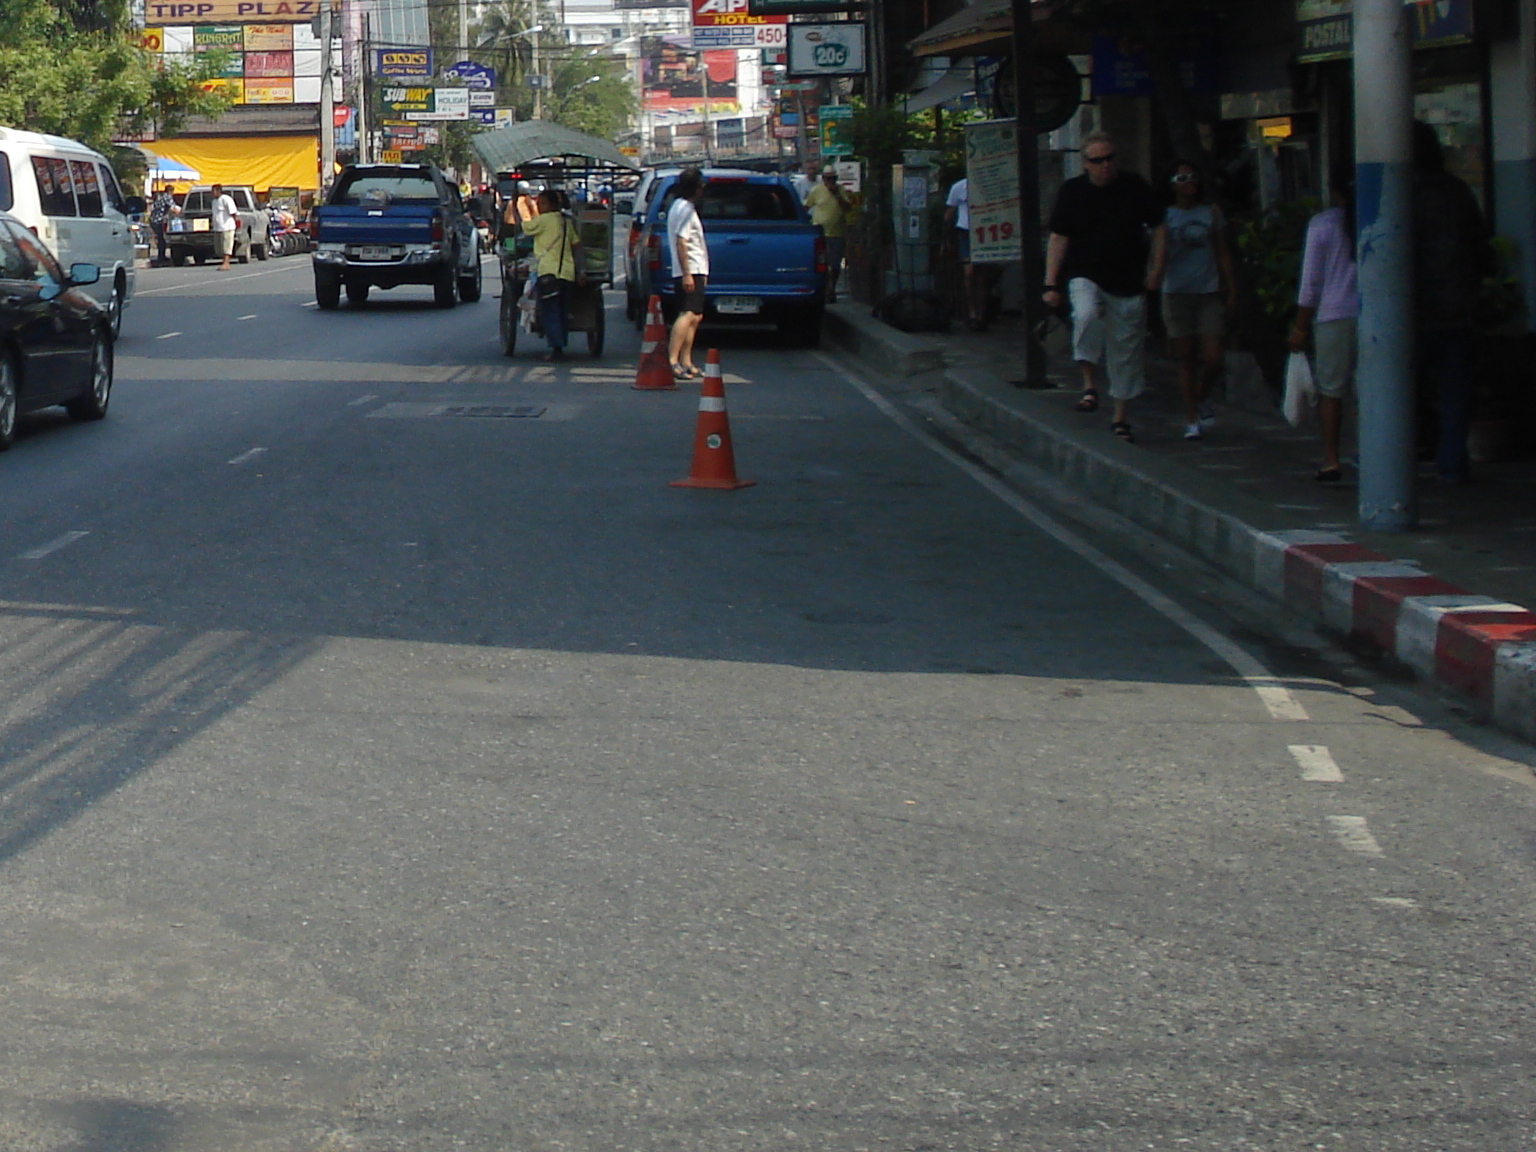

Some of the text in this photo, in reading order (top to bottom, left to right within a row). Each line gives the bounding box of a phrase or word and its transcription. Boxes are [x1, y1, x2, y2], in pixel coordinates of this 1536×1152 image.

[151, 1, 328, 18] TIPP PLAZ
[714, 15, 767, 25] HOTEL
[383, 87, 433, 102] SUBWAY
[974, 221, 1015, 244] 119
